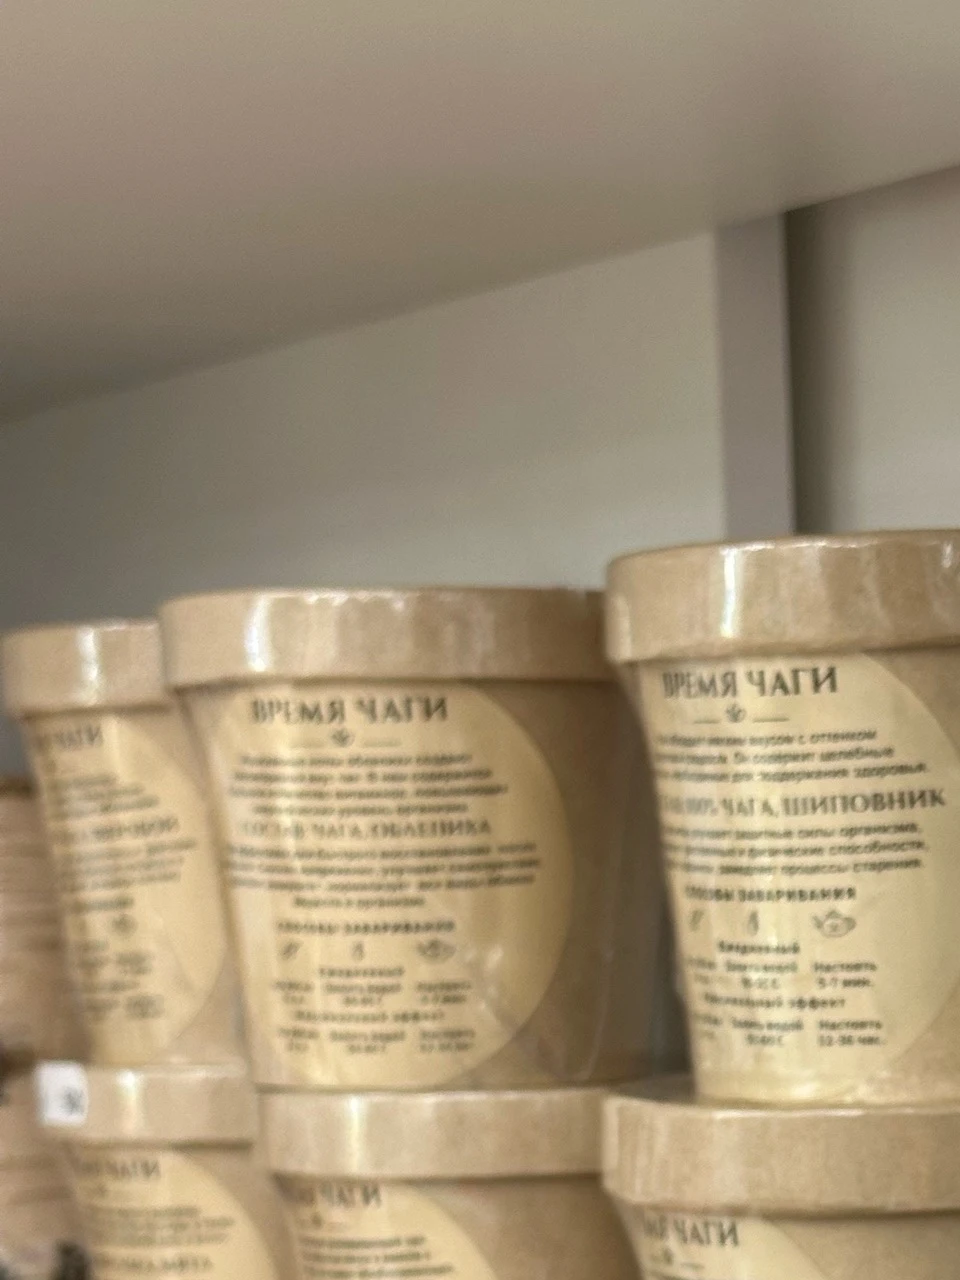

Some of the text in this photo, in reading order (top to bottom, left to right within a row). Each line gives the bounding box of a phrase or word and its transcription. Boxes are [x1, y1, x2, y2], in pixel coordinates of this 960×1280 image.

[746, 666, 839, 696] ЧАГИ
[356, 697, 448, 722] ЧАГИ
[782, 788, 946, 816] ШИПОВНИК
